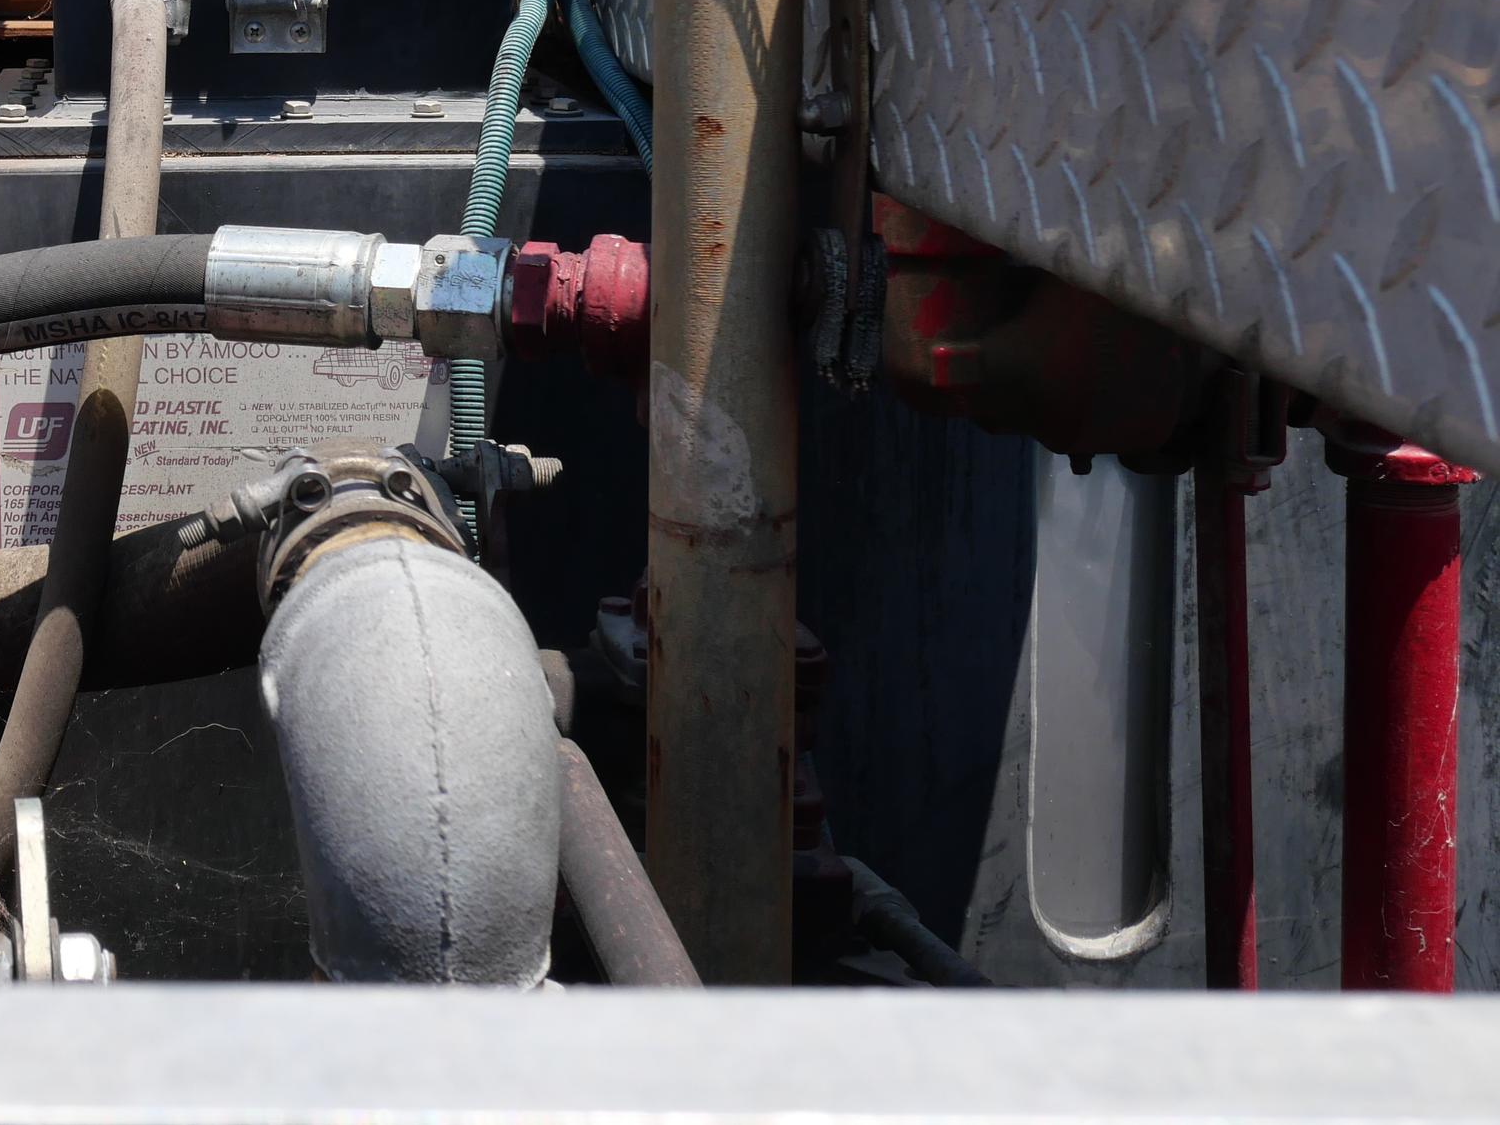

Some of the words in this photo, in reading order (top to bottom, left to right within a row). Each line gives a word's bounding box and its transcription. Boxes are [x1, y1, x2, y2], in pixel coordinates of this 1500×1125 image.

[23, 315, 110, 344] MSHA
[167, 343, 194, 359] BY
[199, 342, 280, 359] AMOCO
[155, 367, 238, 385] CHOICE
[155, 401, 222, 415] PLASTIC
[252, 402, 273, 411] NEW
[298, 402, 348, 411] STABILIZED
[389, 402, 430, 410] NATURAL
[256, 414, 312, 422] COPOLYMER
[315, 414, 337, 422] 100%
[18, 416, 65, 442] UPF
[200, 420, 233, 435] INC.
[327, 425, 353, 433] FAULT
[134, 440, 156, 457] NEW
[156, 456, 199, 466] Standard
[4, 499, 25, 509] 165
[3, 512, 37, 522] North
[4, 525, 26, 535] Toll
